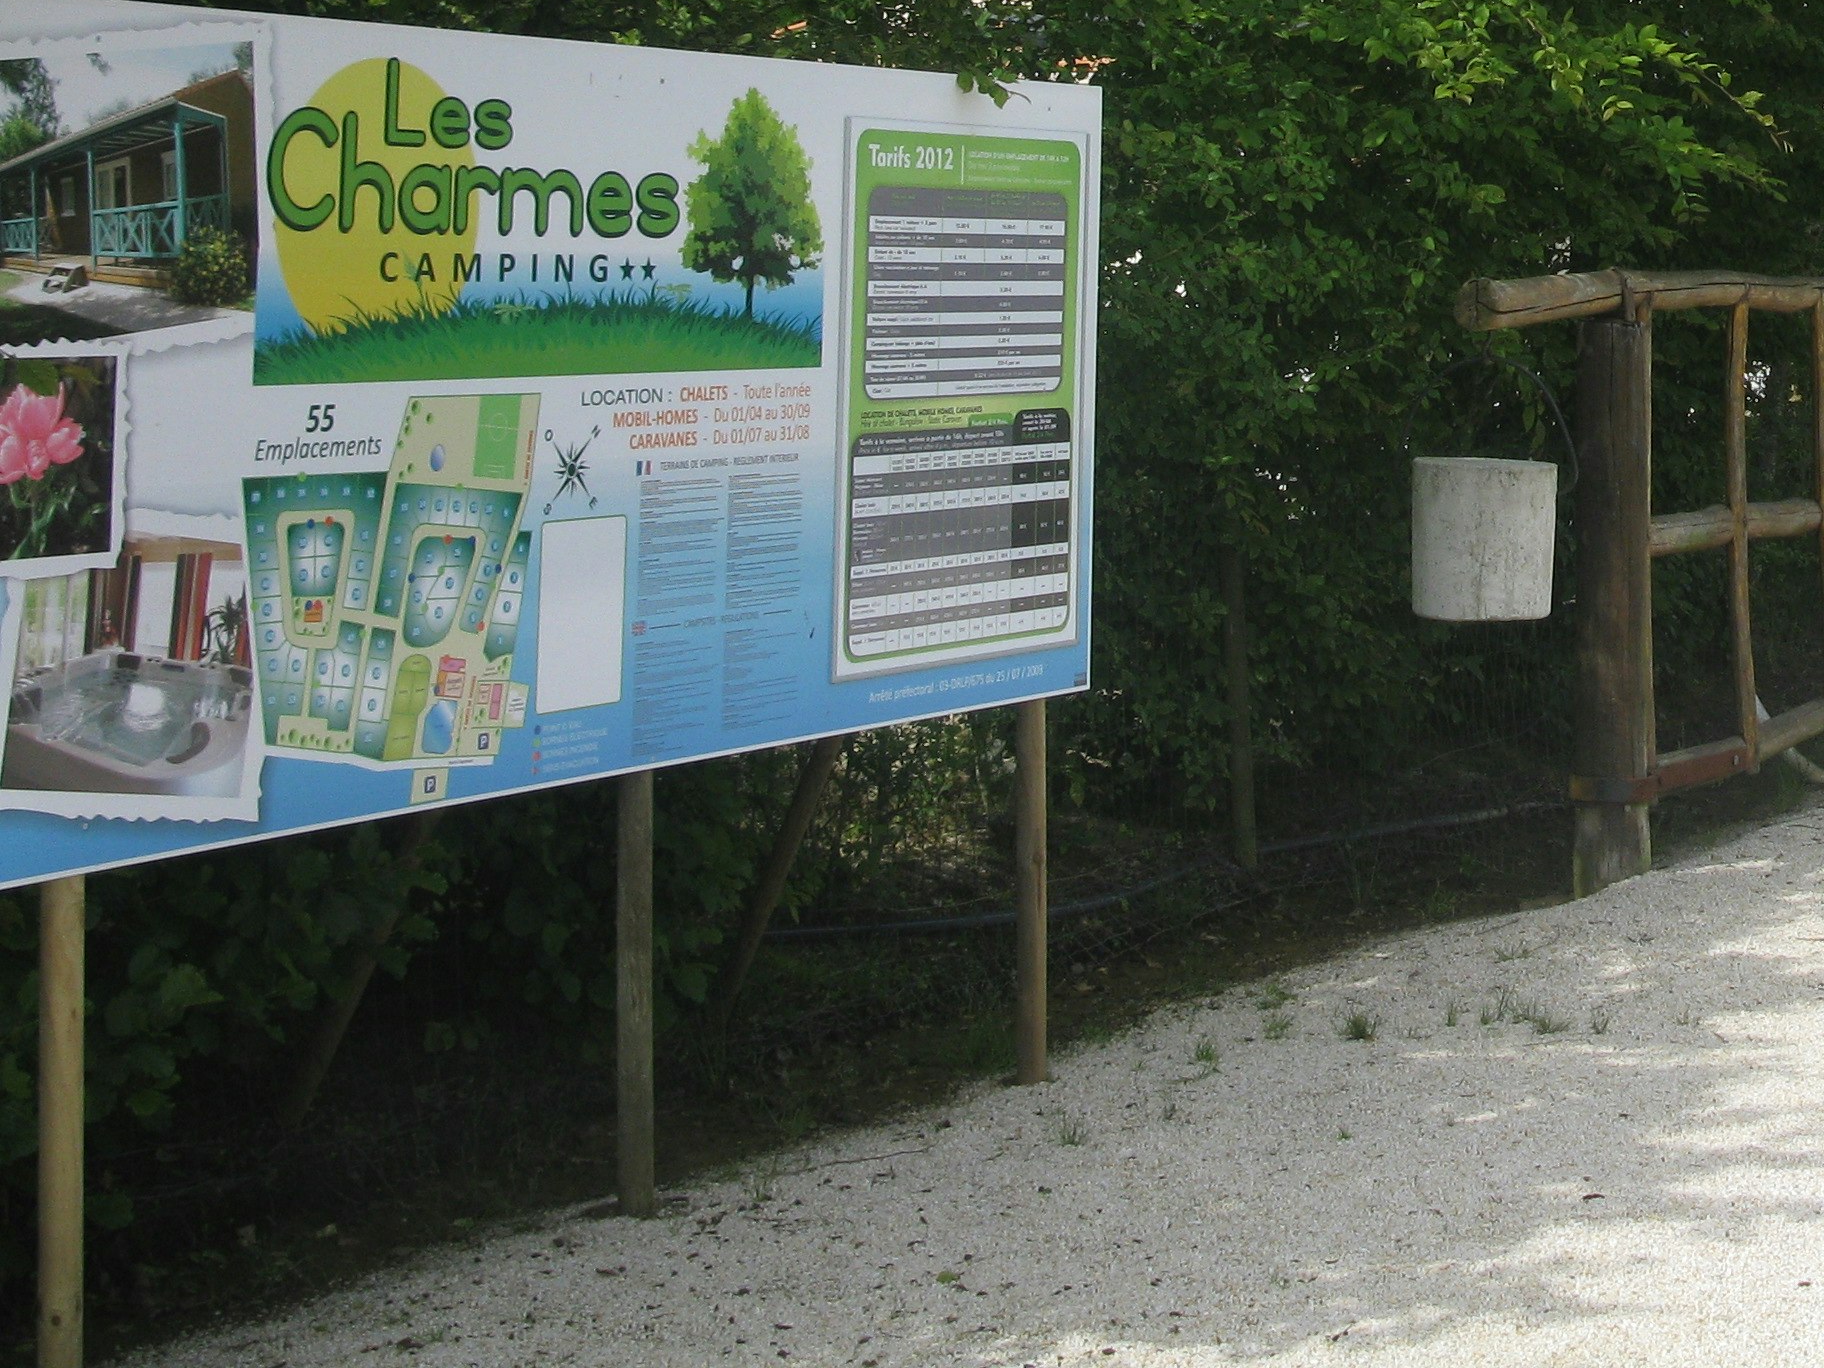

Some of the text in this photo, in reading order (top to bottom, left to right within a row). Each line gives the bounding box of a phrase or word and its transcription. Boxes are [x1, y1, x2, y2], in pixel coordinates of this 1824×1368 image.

[384, 57, 513, 151] Les
[868, 143, 954, 170] Tarifs 2012
[266, 106, 680, 239] Charmes
[379, 251, 609, 284] CAMPING
[581, 388, 663, 406] LOCATION
[680, 385, 729, 402] CHALETS
[743, 384, 772, 399] Toute
[774, 382, 811, 398] l'année
[305, 404, 335, 433] 55
[612, 409, 699, 428] MOBIL-HOMES
[714, 407, 729, 423] Du
[731, 406, 762, 423] 01/04
[764, 408, 777, 420] au
[780, 403, 811, 420] 30/09
[254, 437, 383, 465] Emplacements
[629, 431, 698, 450] CARAVANES
[713, 429, 729, 445] Du
[730, 428, 761, 445] 01/07
[764, 430, 777, 442] au
[780, 425, 810, 442] 31/08
